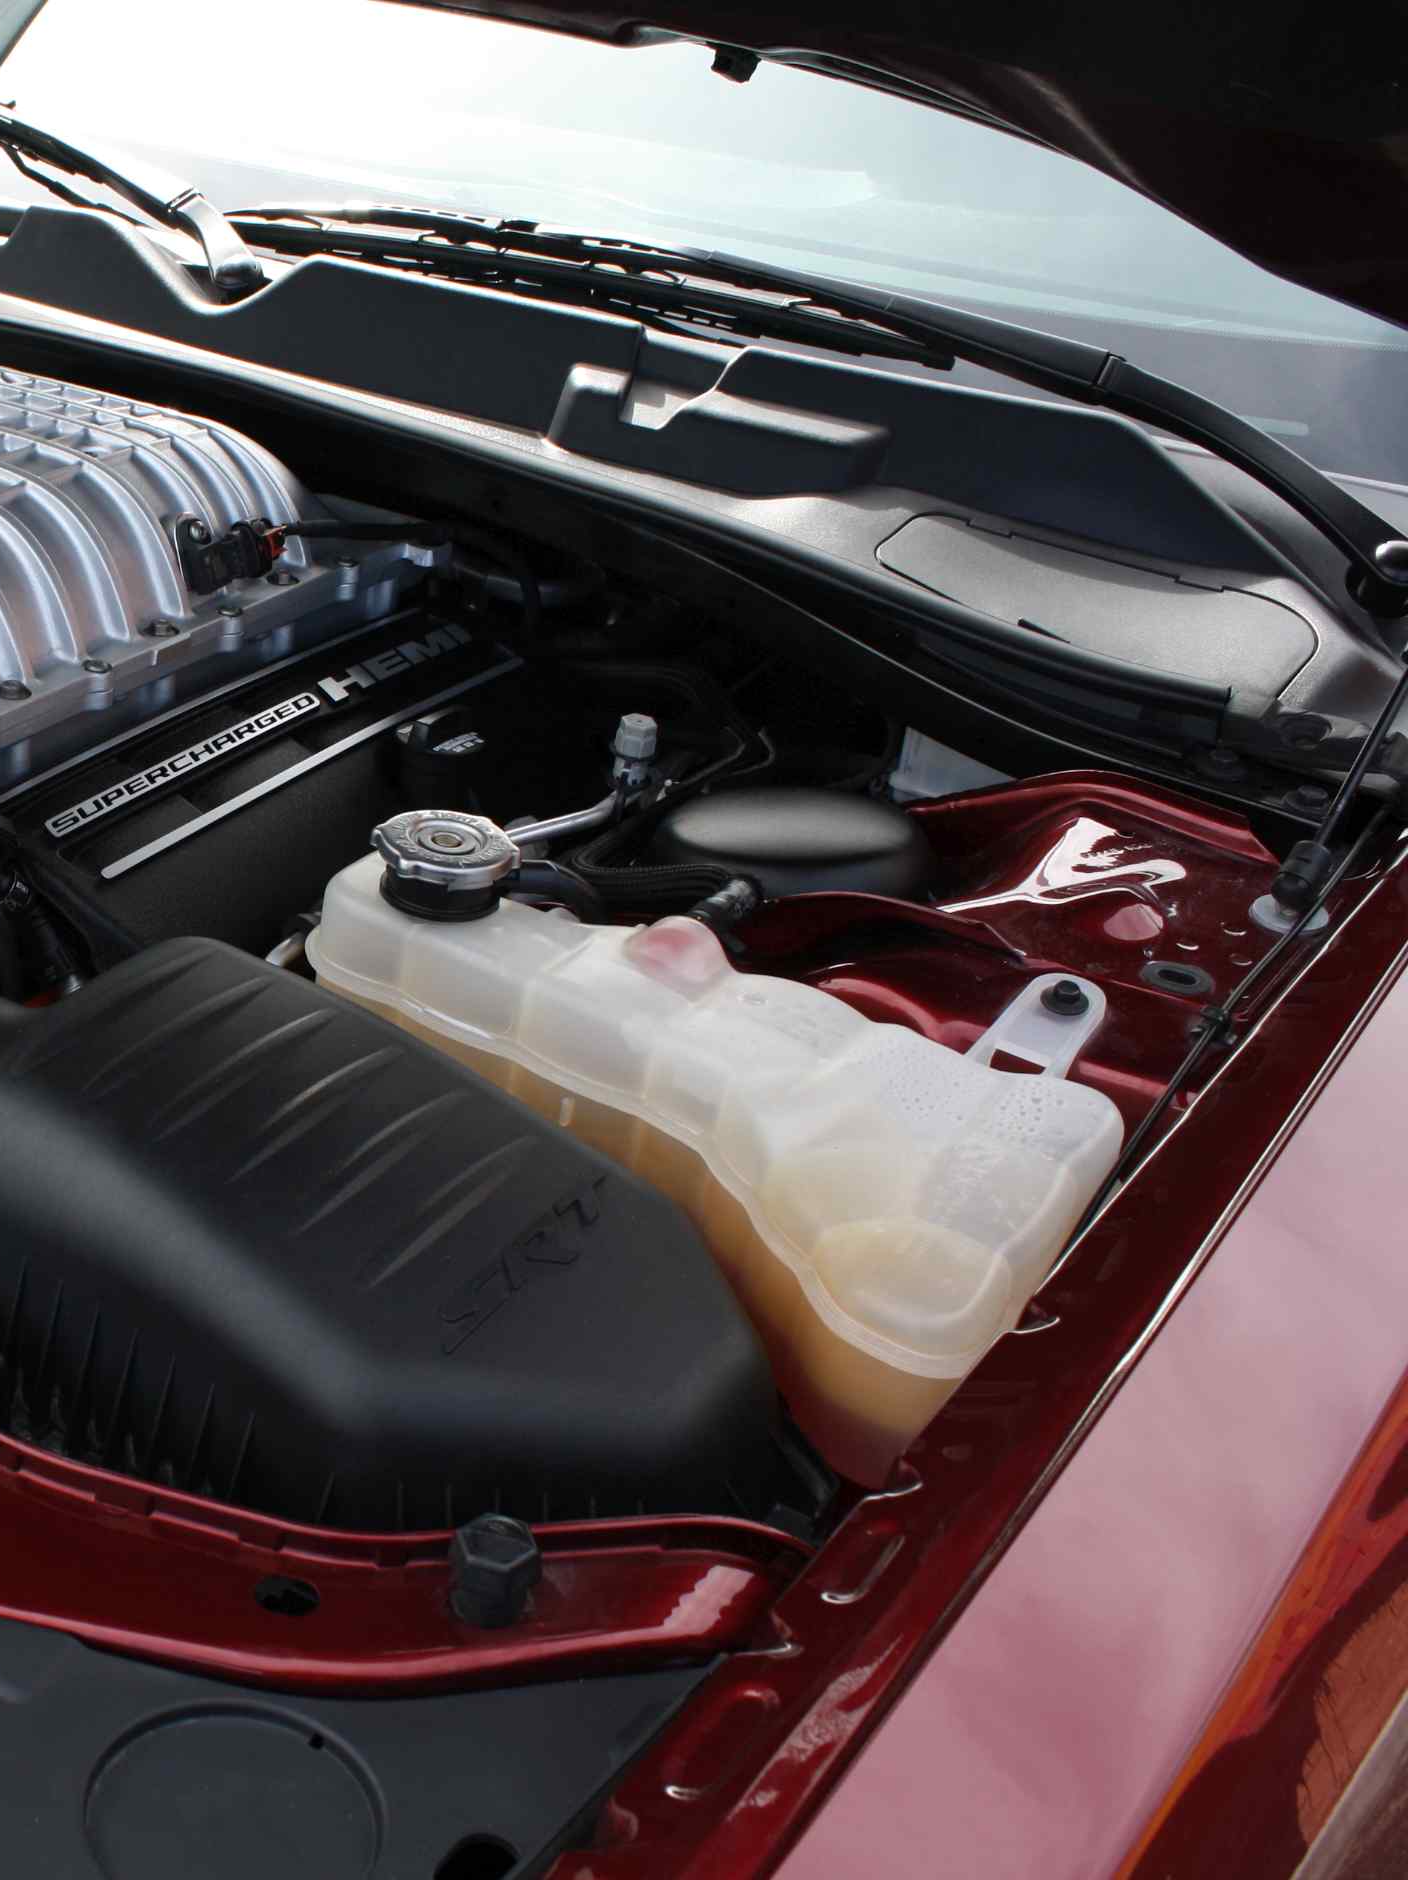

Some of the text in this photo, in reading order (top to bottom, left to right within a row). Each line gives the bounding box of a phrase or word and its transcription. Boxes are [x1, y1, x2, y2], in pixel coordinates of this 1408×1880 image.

[50, 623, 473, 831] SUPERCHARGED HEMI
[438, 1172, 608, 1356] SRT
